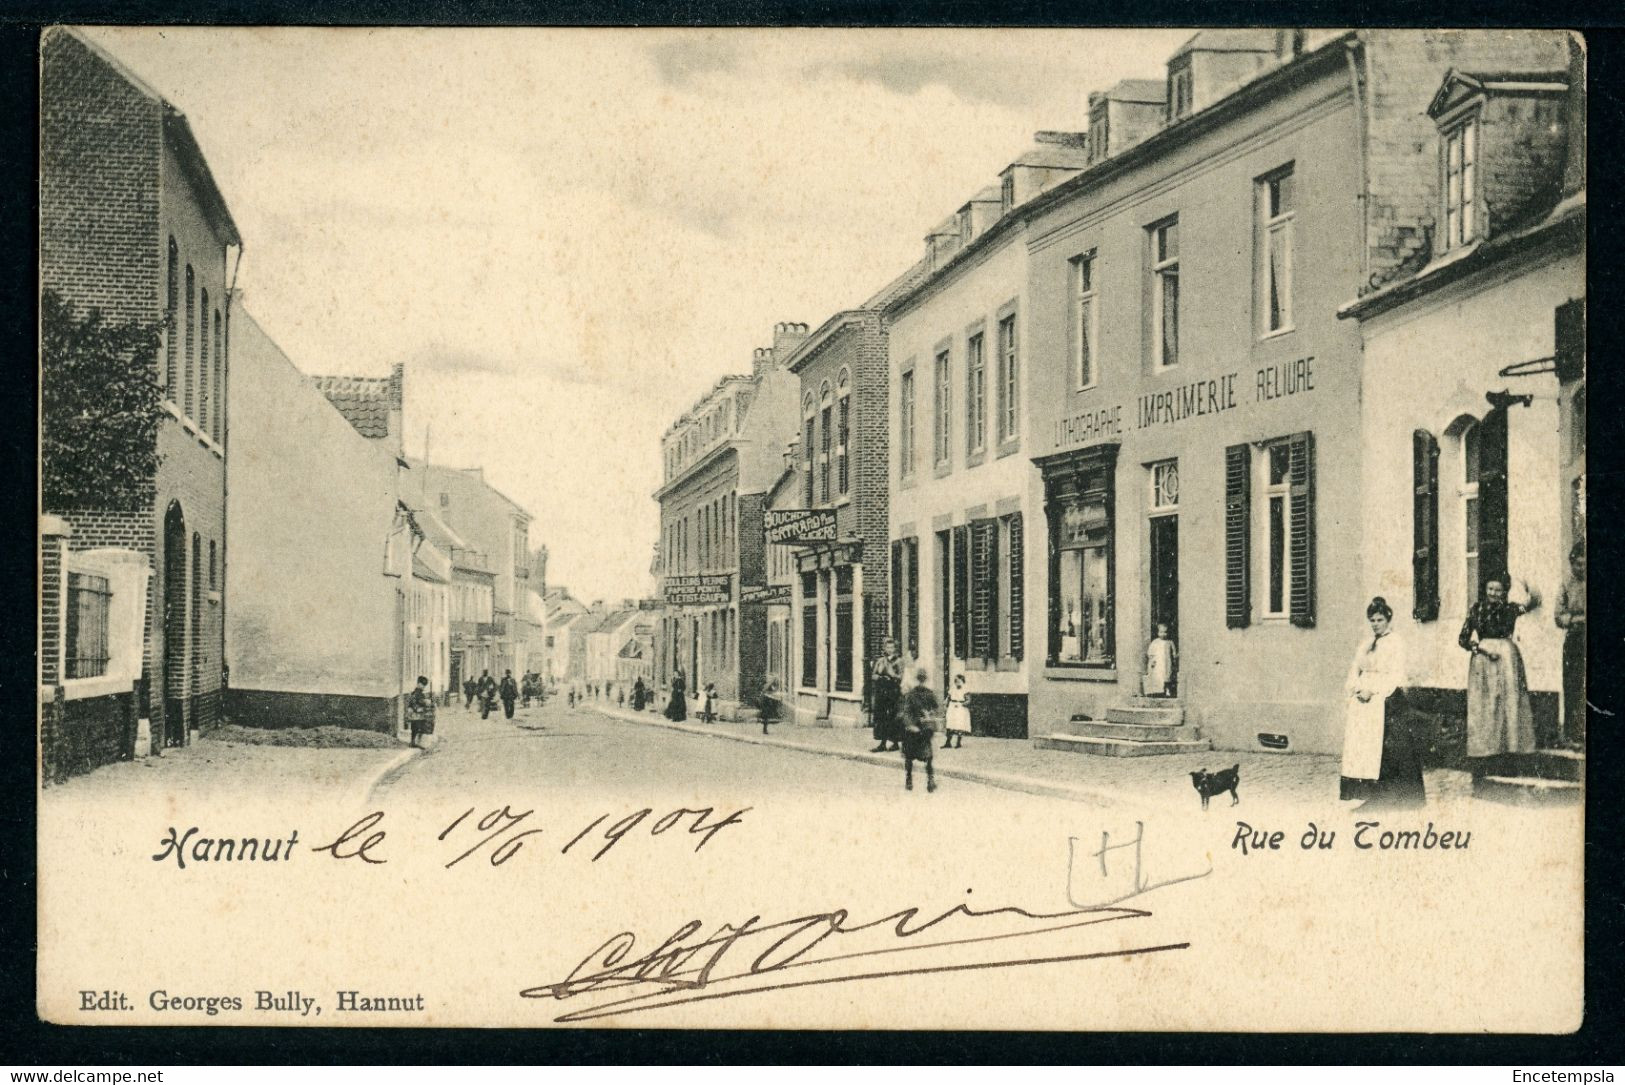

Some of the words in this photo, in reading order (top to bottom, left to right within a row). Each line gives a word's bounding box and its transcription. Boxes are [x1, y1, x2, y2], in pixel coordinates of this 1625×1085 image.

[1054, 404, 1122, 448] LITHOGRAPHIE
[1137, 373, 1238, 429] IMPRIMERIE
[1256, 356, 1315, 402] RELIURE
[152, 827, 299, 868] Hannut
[312, 811, 387, 865] le
[561, 806, 746, 861] 1904
[1231, 821, 1285, 856] Rue
[1300, 822, 1336, 850] du
[1353, 821, 1471, 850] Tombeu
[78, 990, 135, 1011] Edit.
[149, 990, 243, 1016] Georges
[254, 991, 322, 1017] Bully,
[336, 991, 425, 1012] Hannut
